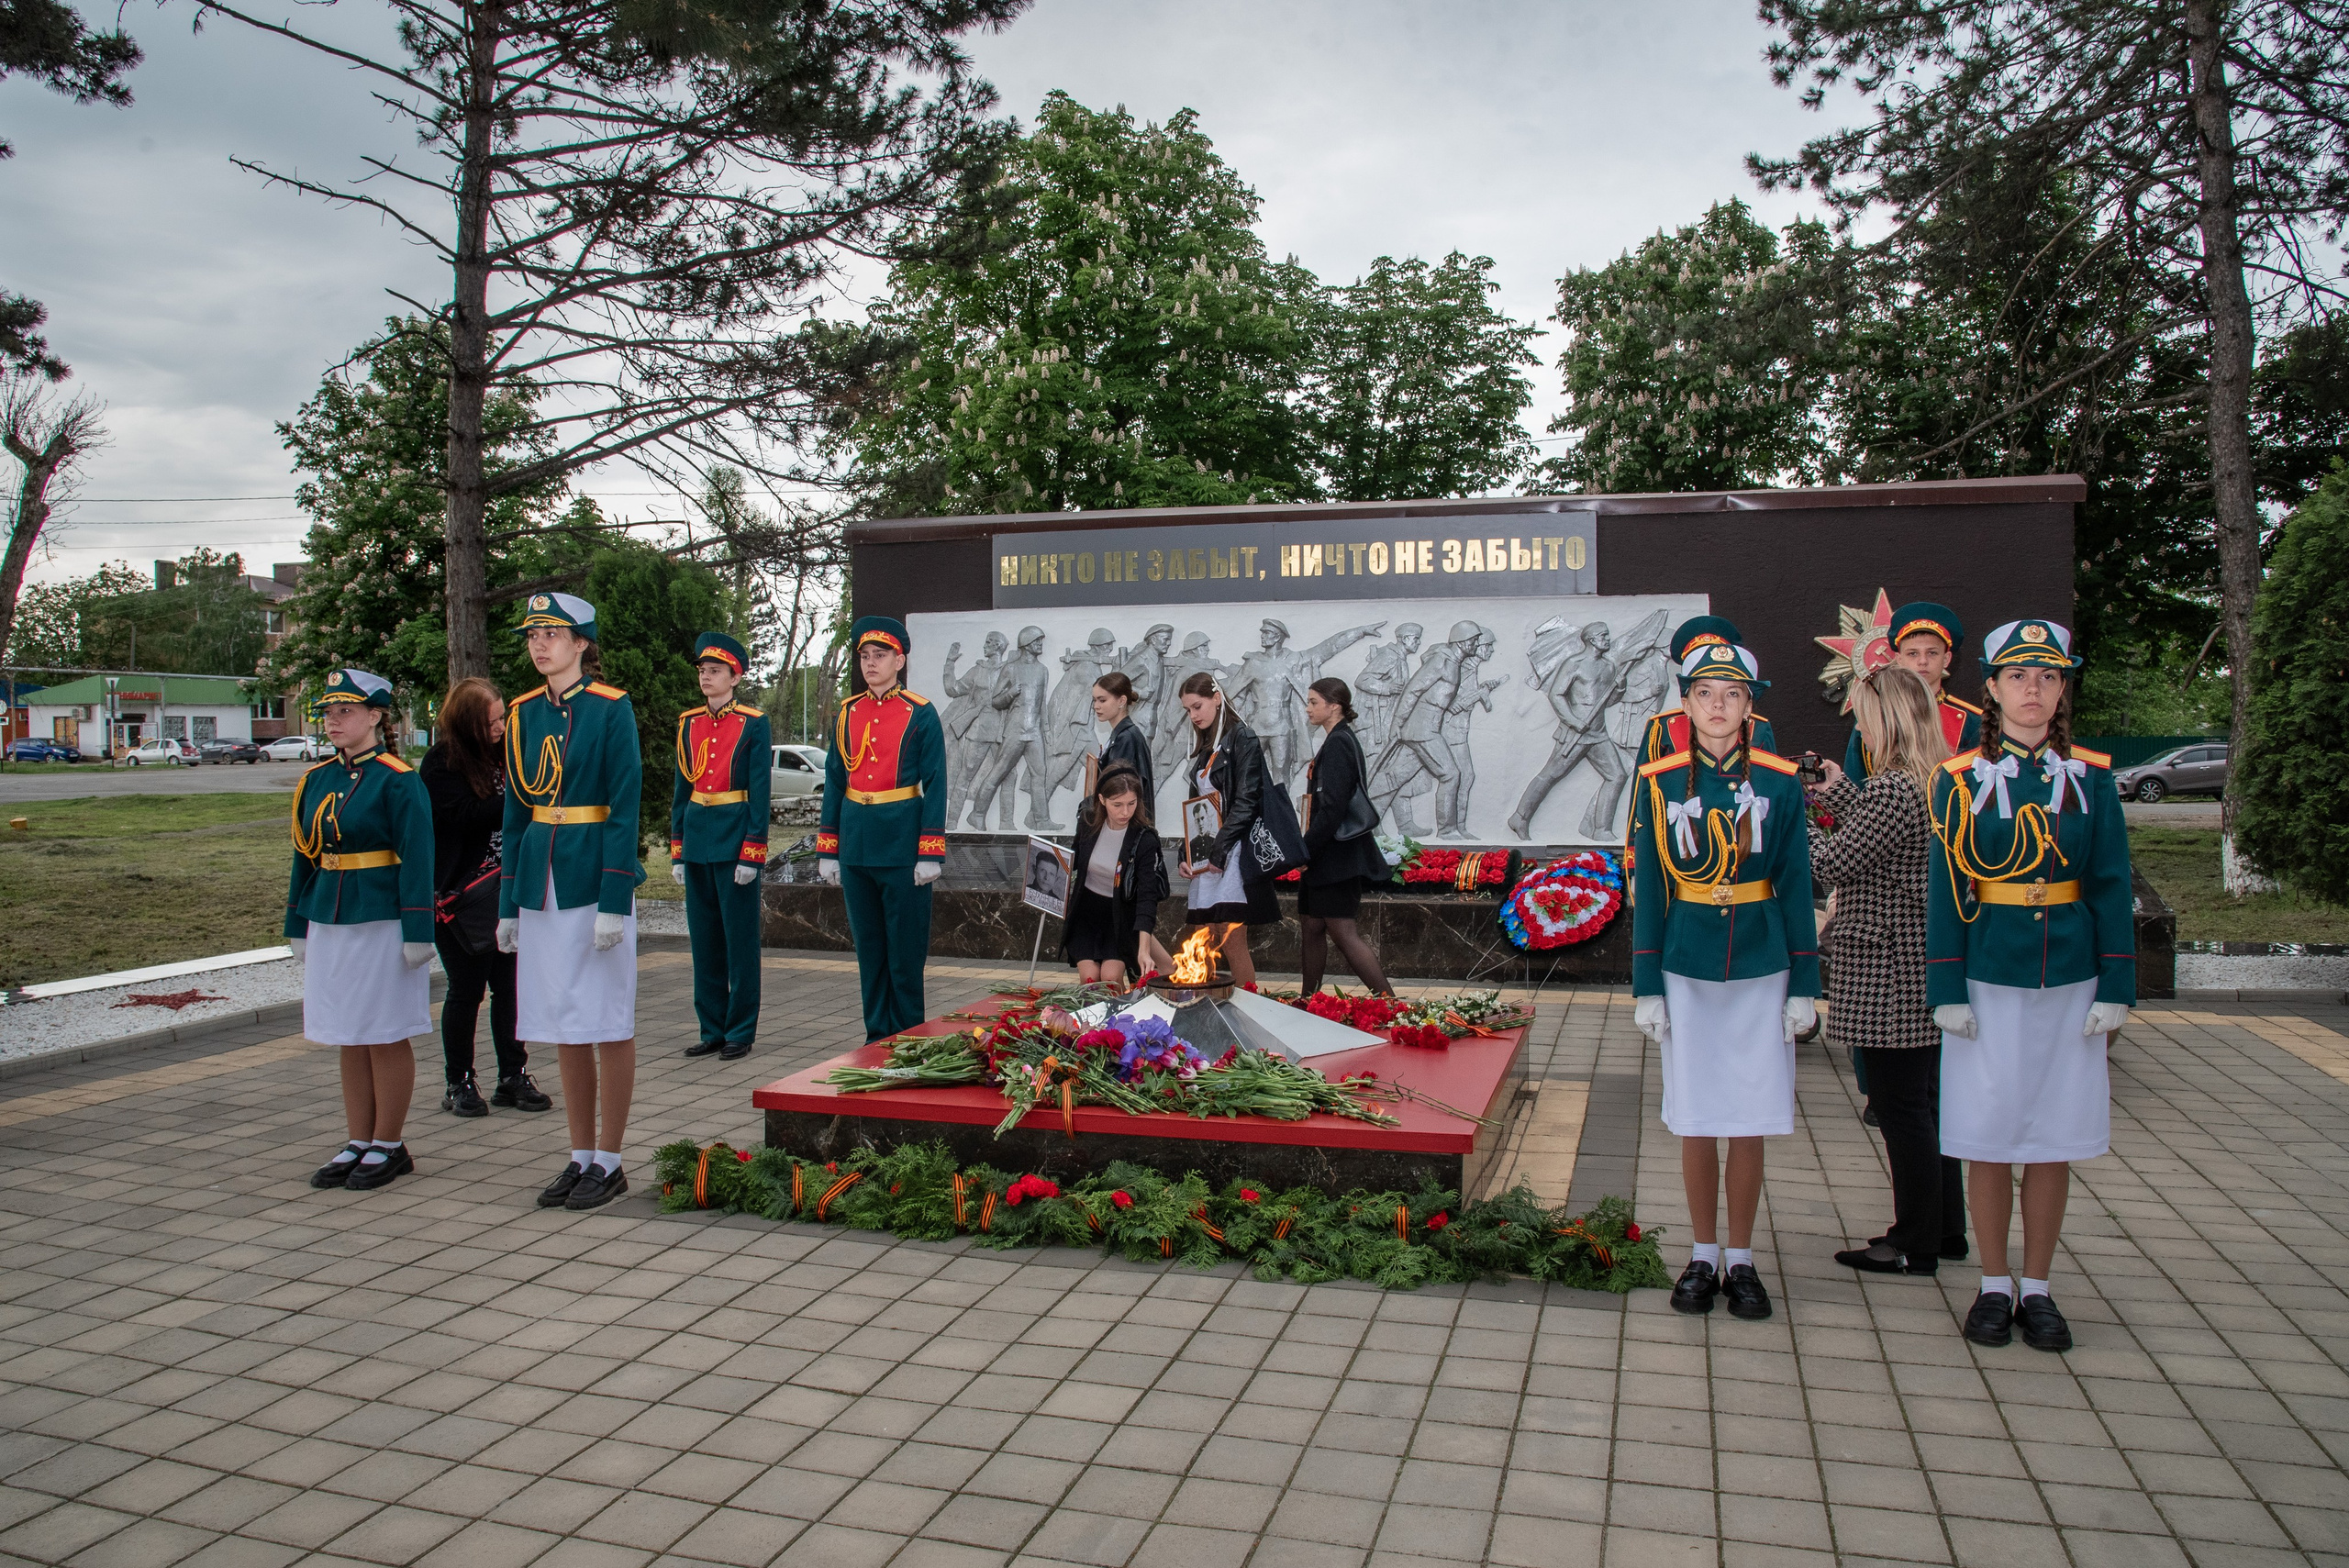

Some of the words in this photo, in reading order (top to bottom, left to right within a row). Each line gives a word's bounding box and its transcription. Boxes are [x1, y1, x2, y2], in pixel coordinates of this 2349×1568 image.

[1000, 551, 1096, 586] НИКТО
[1104, 551, 1140, 583] НЕ
[1146, 546, 1266, 582] ЗАБЫТ,
[1281, 541, 1389, 577] НИЧТО
[1394, 540, 1434, 574] НЕ
[1442, 536, 1586, 573] ЗАБЫТО
